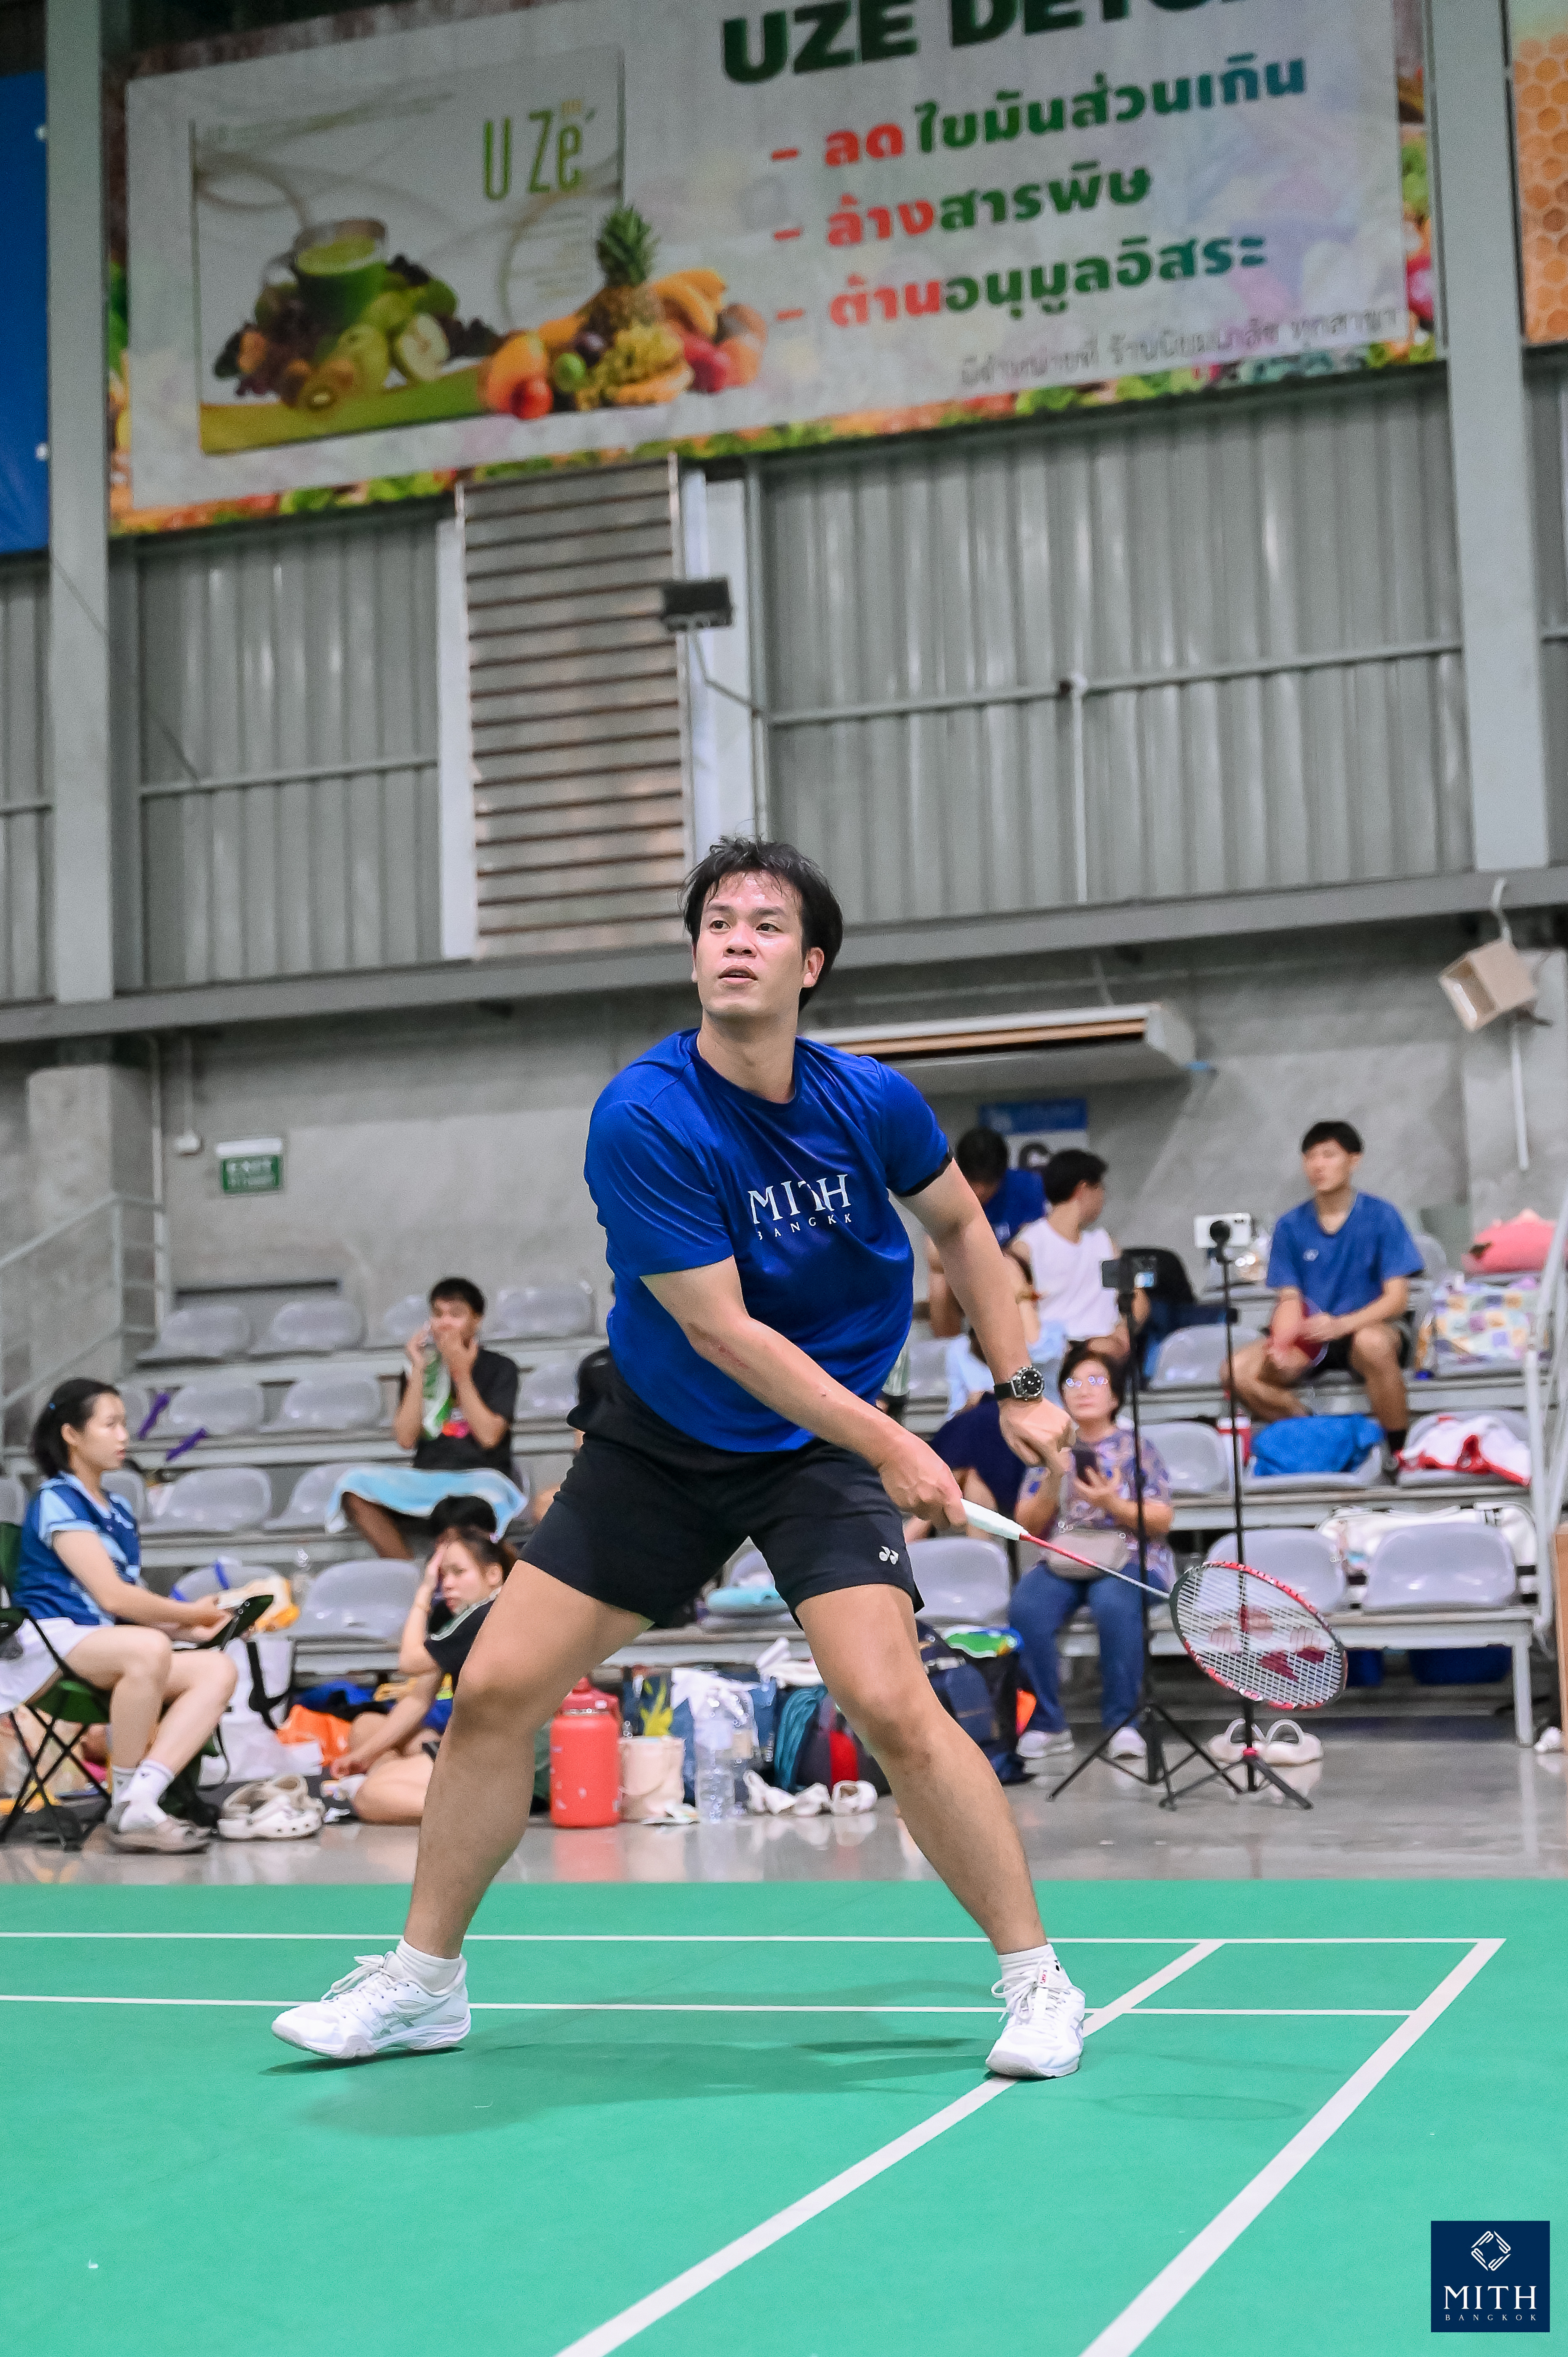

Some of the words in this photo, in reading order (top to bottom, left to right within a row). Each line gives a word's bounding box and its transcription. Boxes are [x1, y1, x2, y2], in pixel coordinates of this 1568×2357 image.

[723, 0, 919, 83] UZE
[824, 52, 1307, 167] ลดไขมันส่วนเกิน
[827, 161, 1153, 247] ล้างสารพิษ
[829, 235, 1267, 327] ต้านอนุมูลอิสระ
